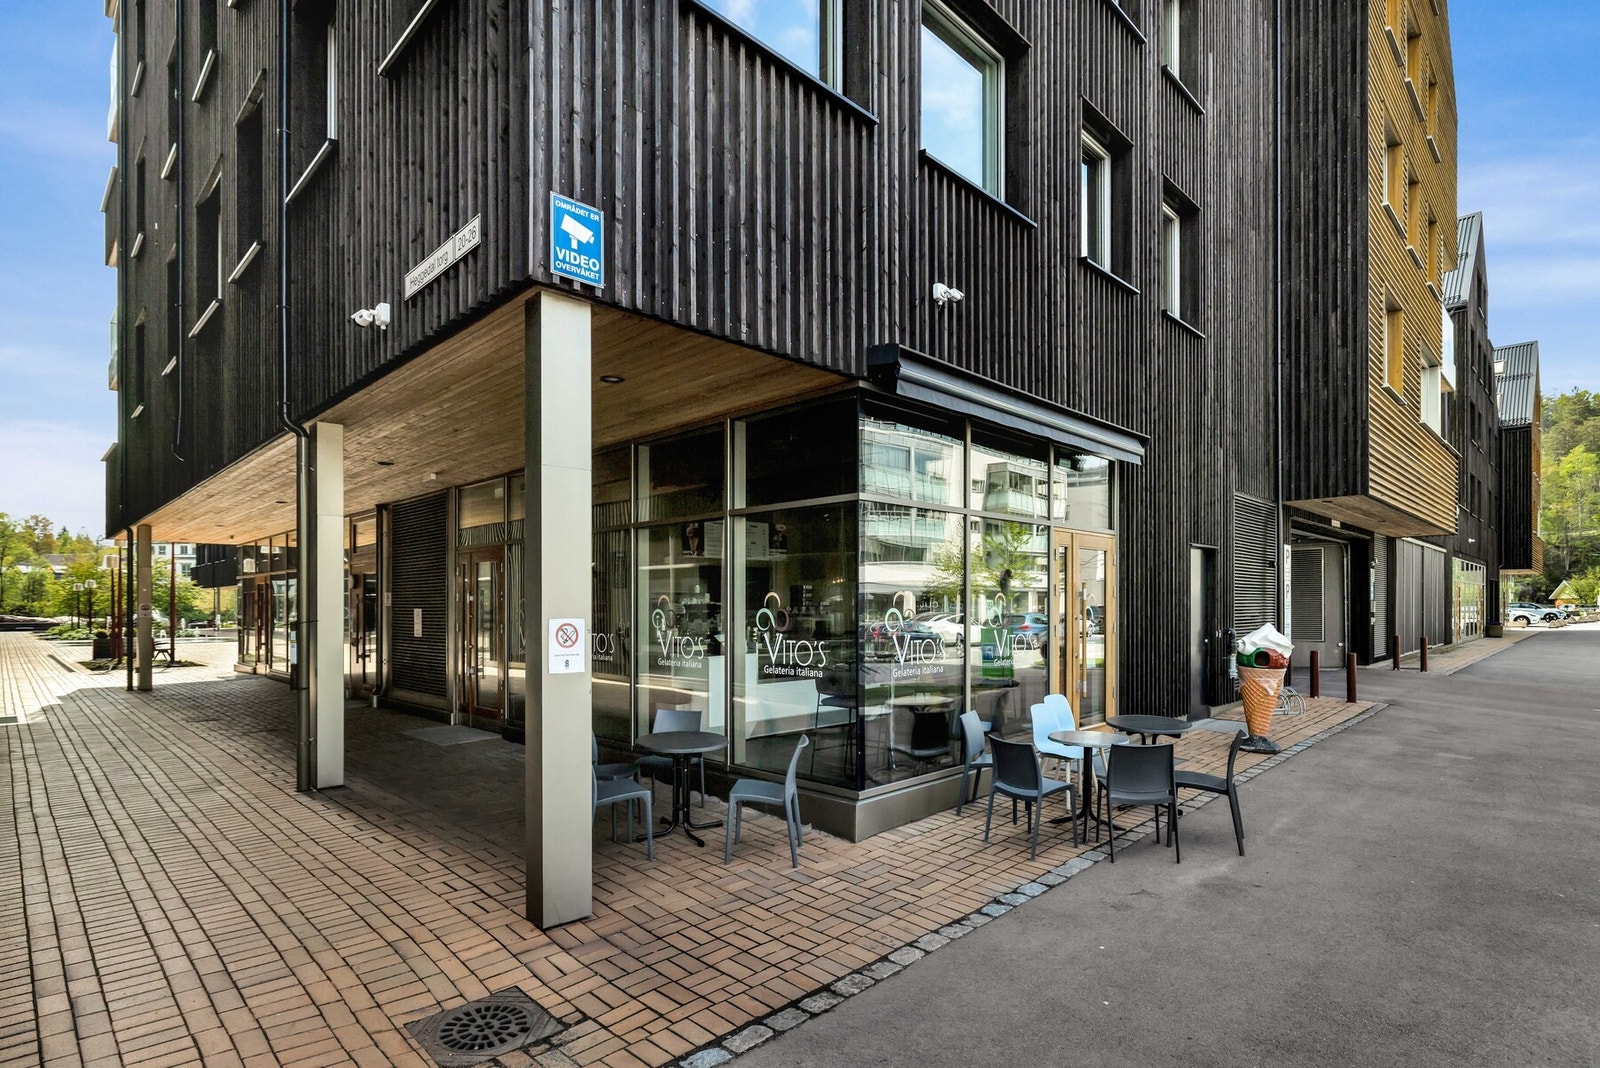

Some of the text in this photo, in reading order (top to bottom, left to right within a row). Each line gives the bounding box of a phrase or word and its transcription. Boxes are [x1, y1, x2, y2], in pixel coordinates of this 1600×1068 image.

[555, 200, 600, 222] OMRÅDET ER
[409, 225, 477, 290] Heggedal torg 20-26
[555, 246, 600, 272] VIDEO
[555, 261, 600, 280] OVERVÅKET
[657, 657, 702, 669] Gelateria italiana
[763, 665, 823, 678] Gelateria italiana
[892, 666, 921, 678] Gelateria
